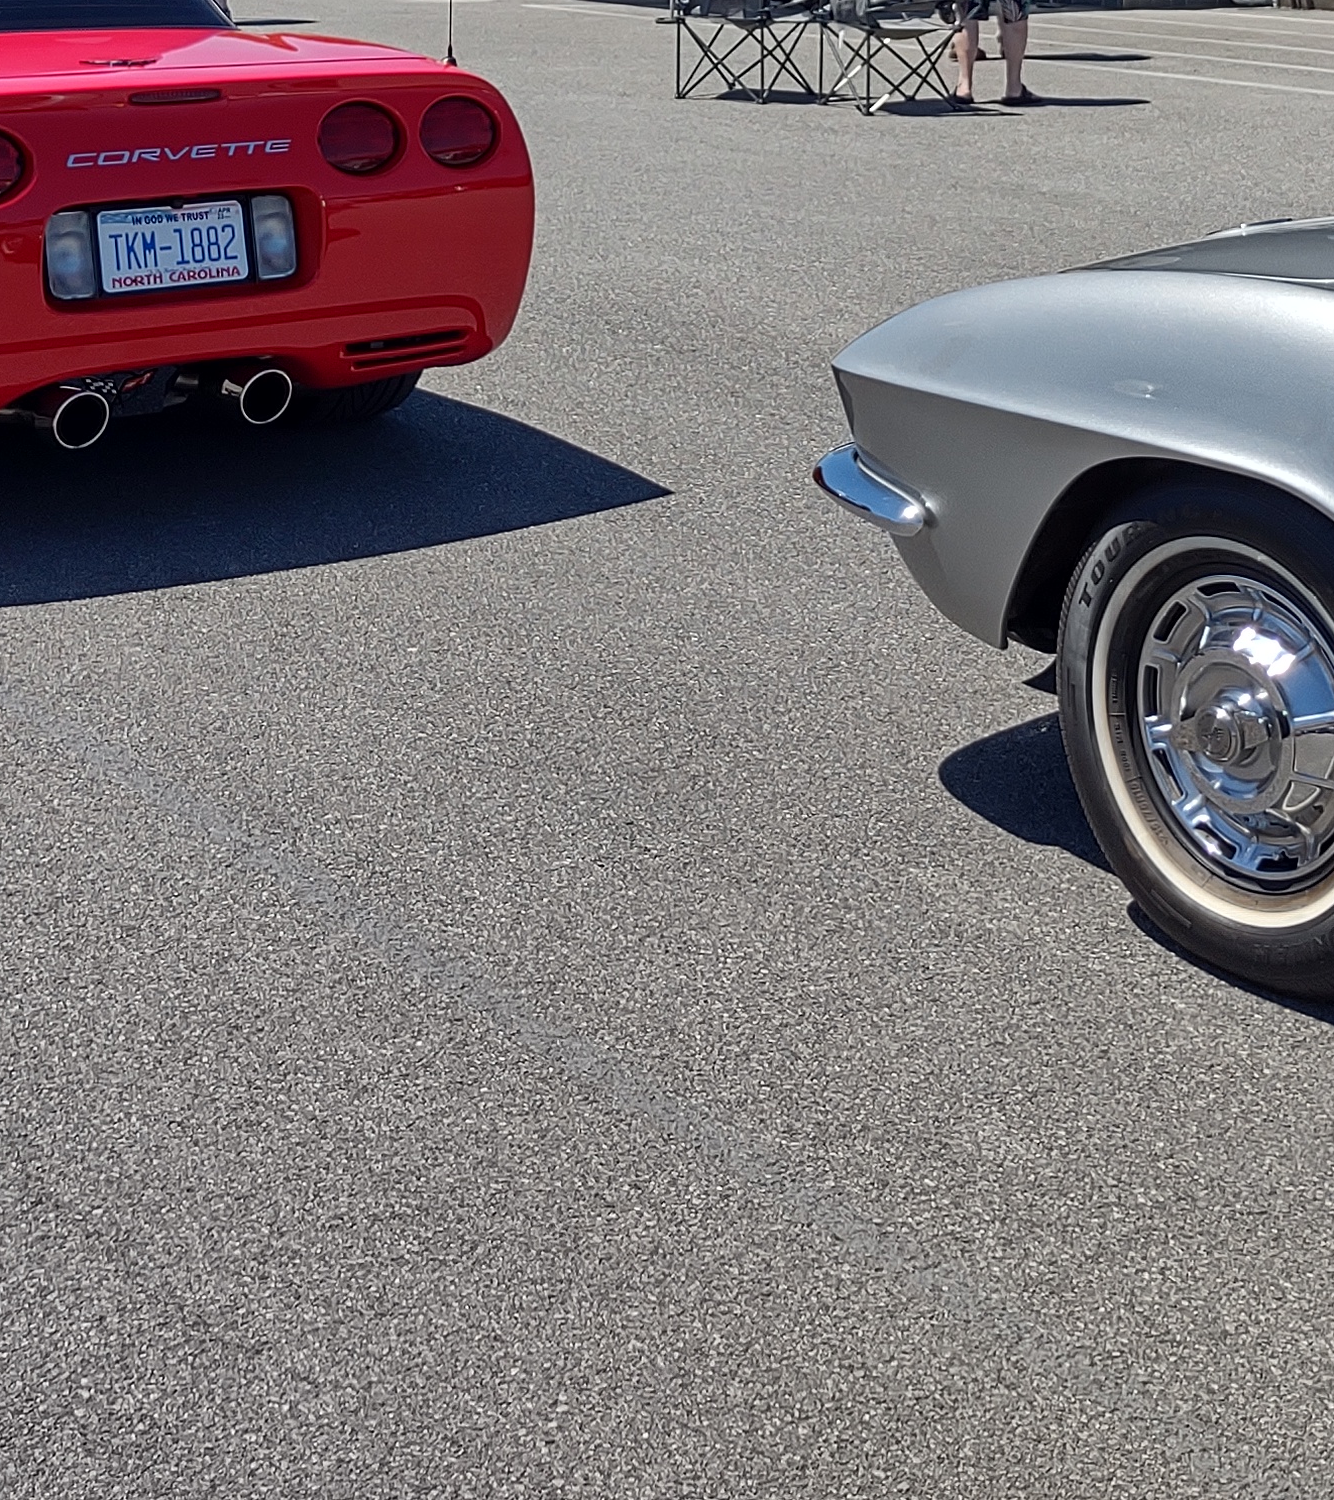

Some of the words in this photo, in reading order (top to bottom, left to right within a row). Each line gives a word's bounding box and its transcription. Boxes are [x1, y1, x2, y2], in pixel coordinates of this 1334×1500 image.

[66, 139, 292, 168] CORVETTE
[131, 216, 142, 226] IN
[144, 214, 164, 225] GOD
[166, 213, 179, 223] WE
[180, 211, 210, 222] TRUST
[108, 224, 238, 271] TKM-1882
[112, 271, 163, 289] NORTH
[169, 266, 241, 283] CAROLINA
